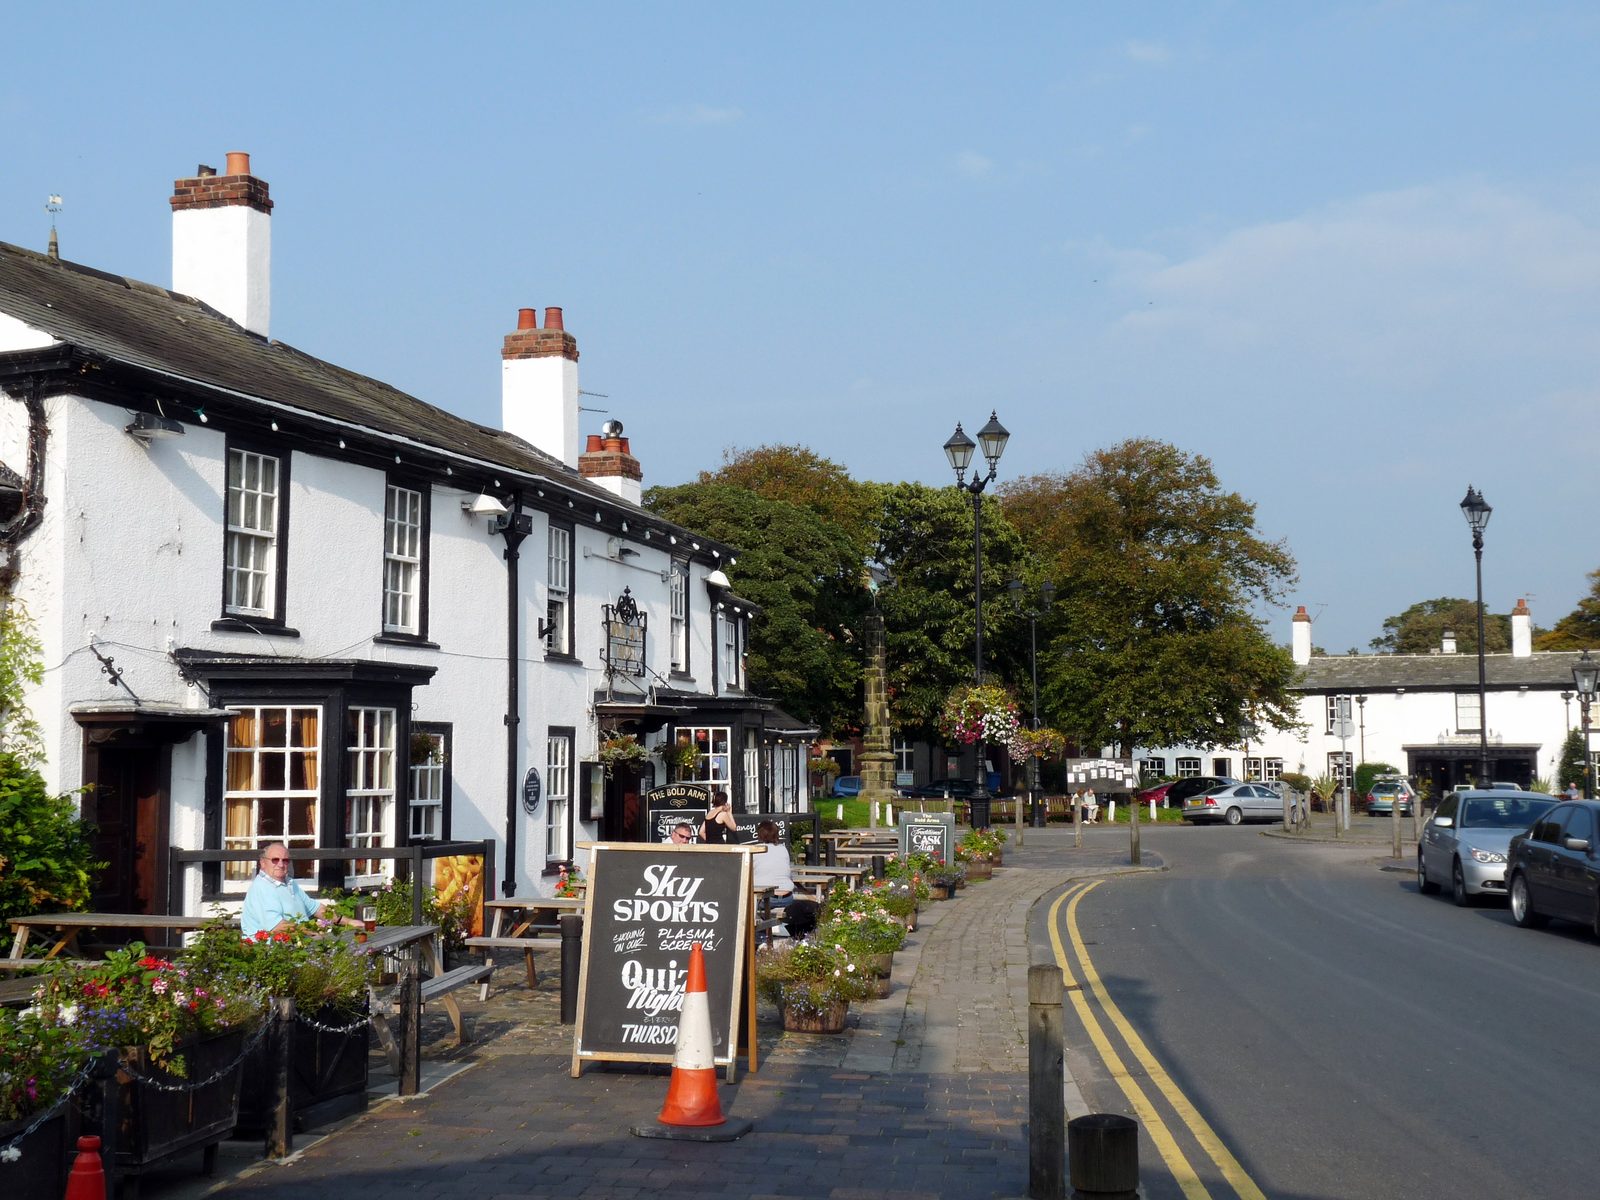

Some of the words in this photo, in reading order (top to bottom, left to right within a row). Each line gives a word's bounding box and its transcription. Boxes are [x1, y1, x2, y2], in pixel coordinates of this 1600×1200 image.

[650, 790, 665, 801] THE
[666, 787, 685, 797] BOLD
[687, 788, 707, 801] ARMS
[736, 824, 756, 833] ancy
[912, 835, 942, 845] CASK
[635, 864, 704, 908] Sky
[613, 899, 719, 923] SPORTS
[657, 928, 716, 940] PLASMA
[614, 942, 625, 953] ON
[626, 937, 648, 950] OUR
[621, 1024, 680, 1045] THURSD
